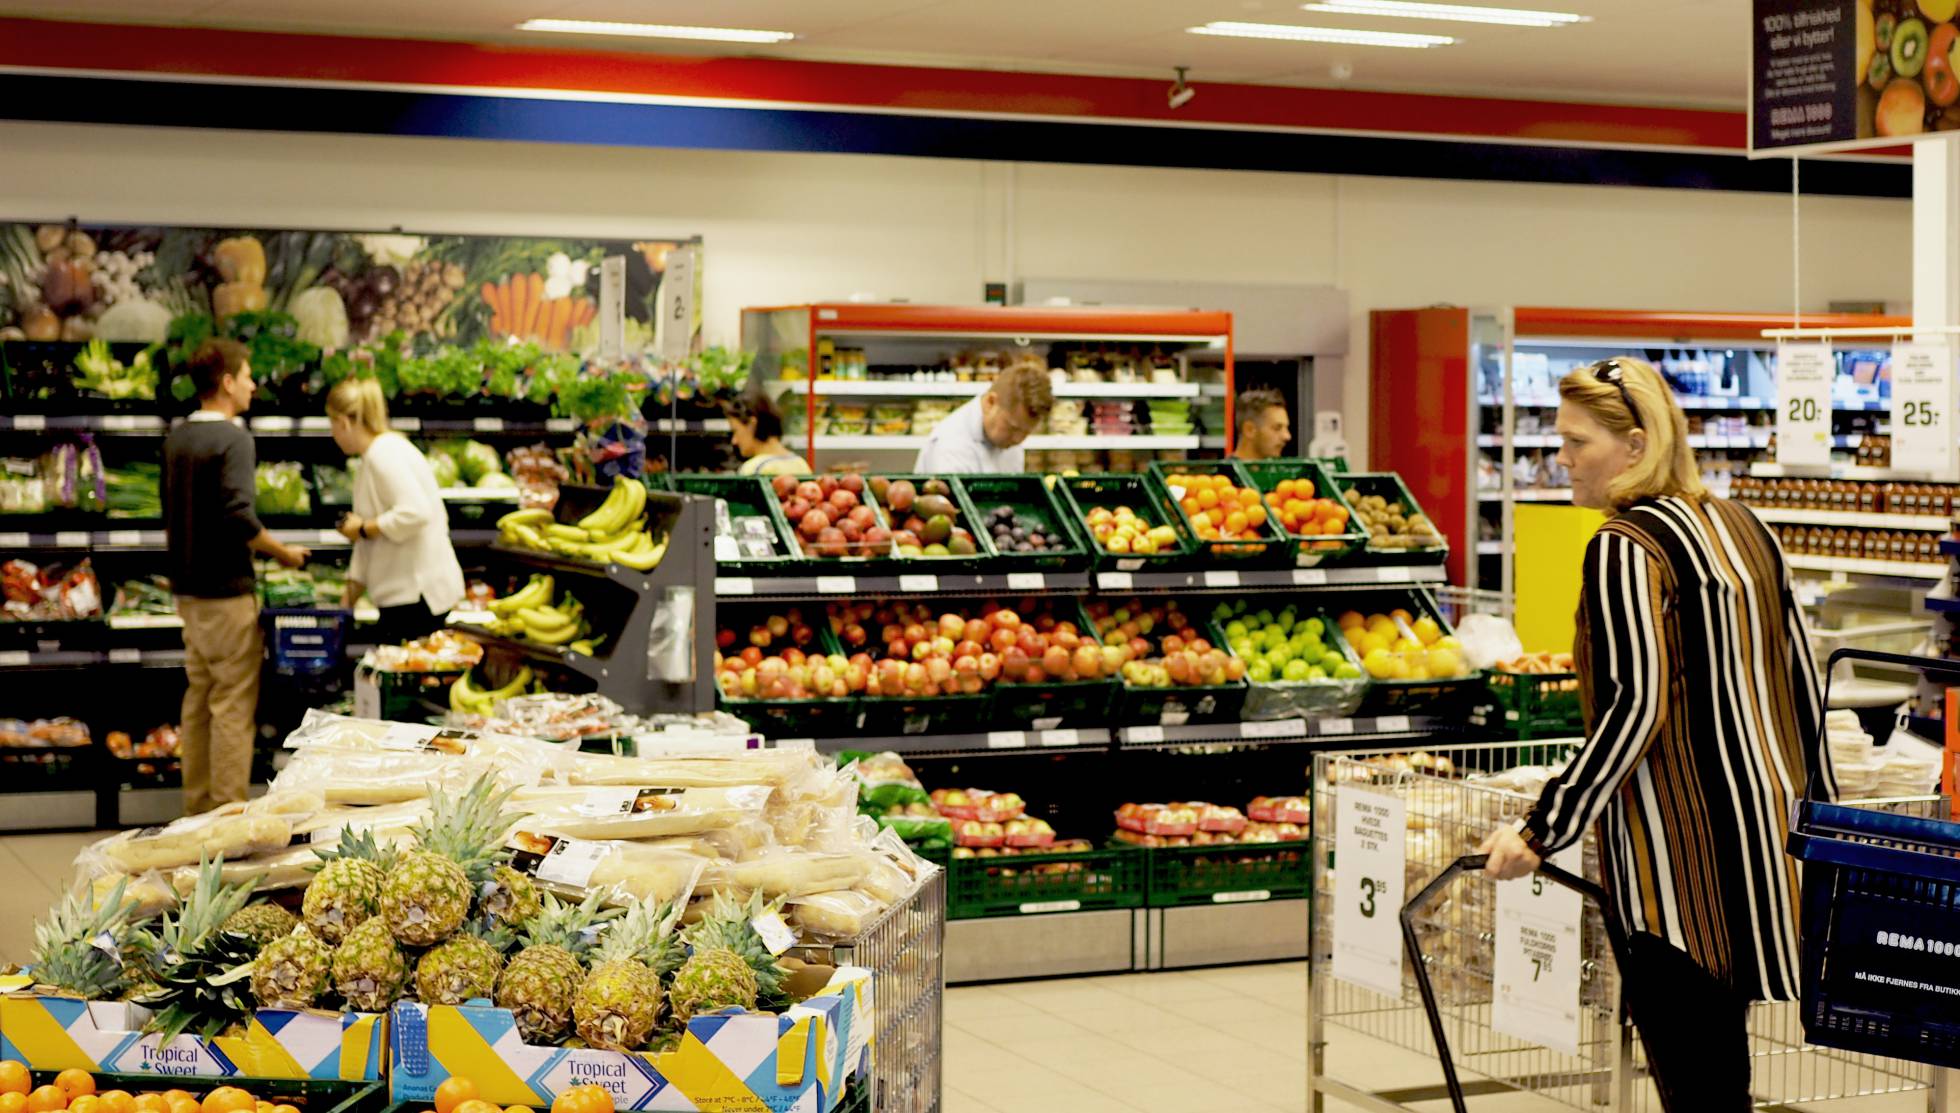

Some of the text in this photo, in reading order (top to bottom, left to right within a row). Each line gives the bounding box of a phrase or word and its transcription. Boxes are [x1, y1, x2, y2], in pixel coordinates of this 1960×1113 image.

[1876, 930, 1925, 951] REMA
[1854, 971, 1867, 981] MÅ
[1868, 973, 1885, 984] IKKE
[1885, 976, 1918, 989] FJERNES
[1919, 982, 1934, 992] FRA
[140, 1044, 198, 1063] Tropical
[567, 1060, 626, 1078] Tropical
